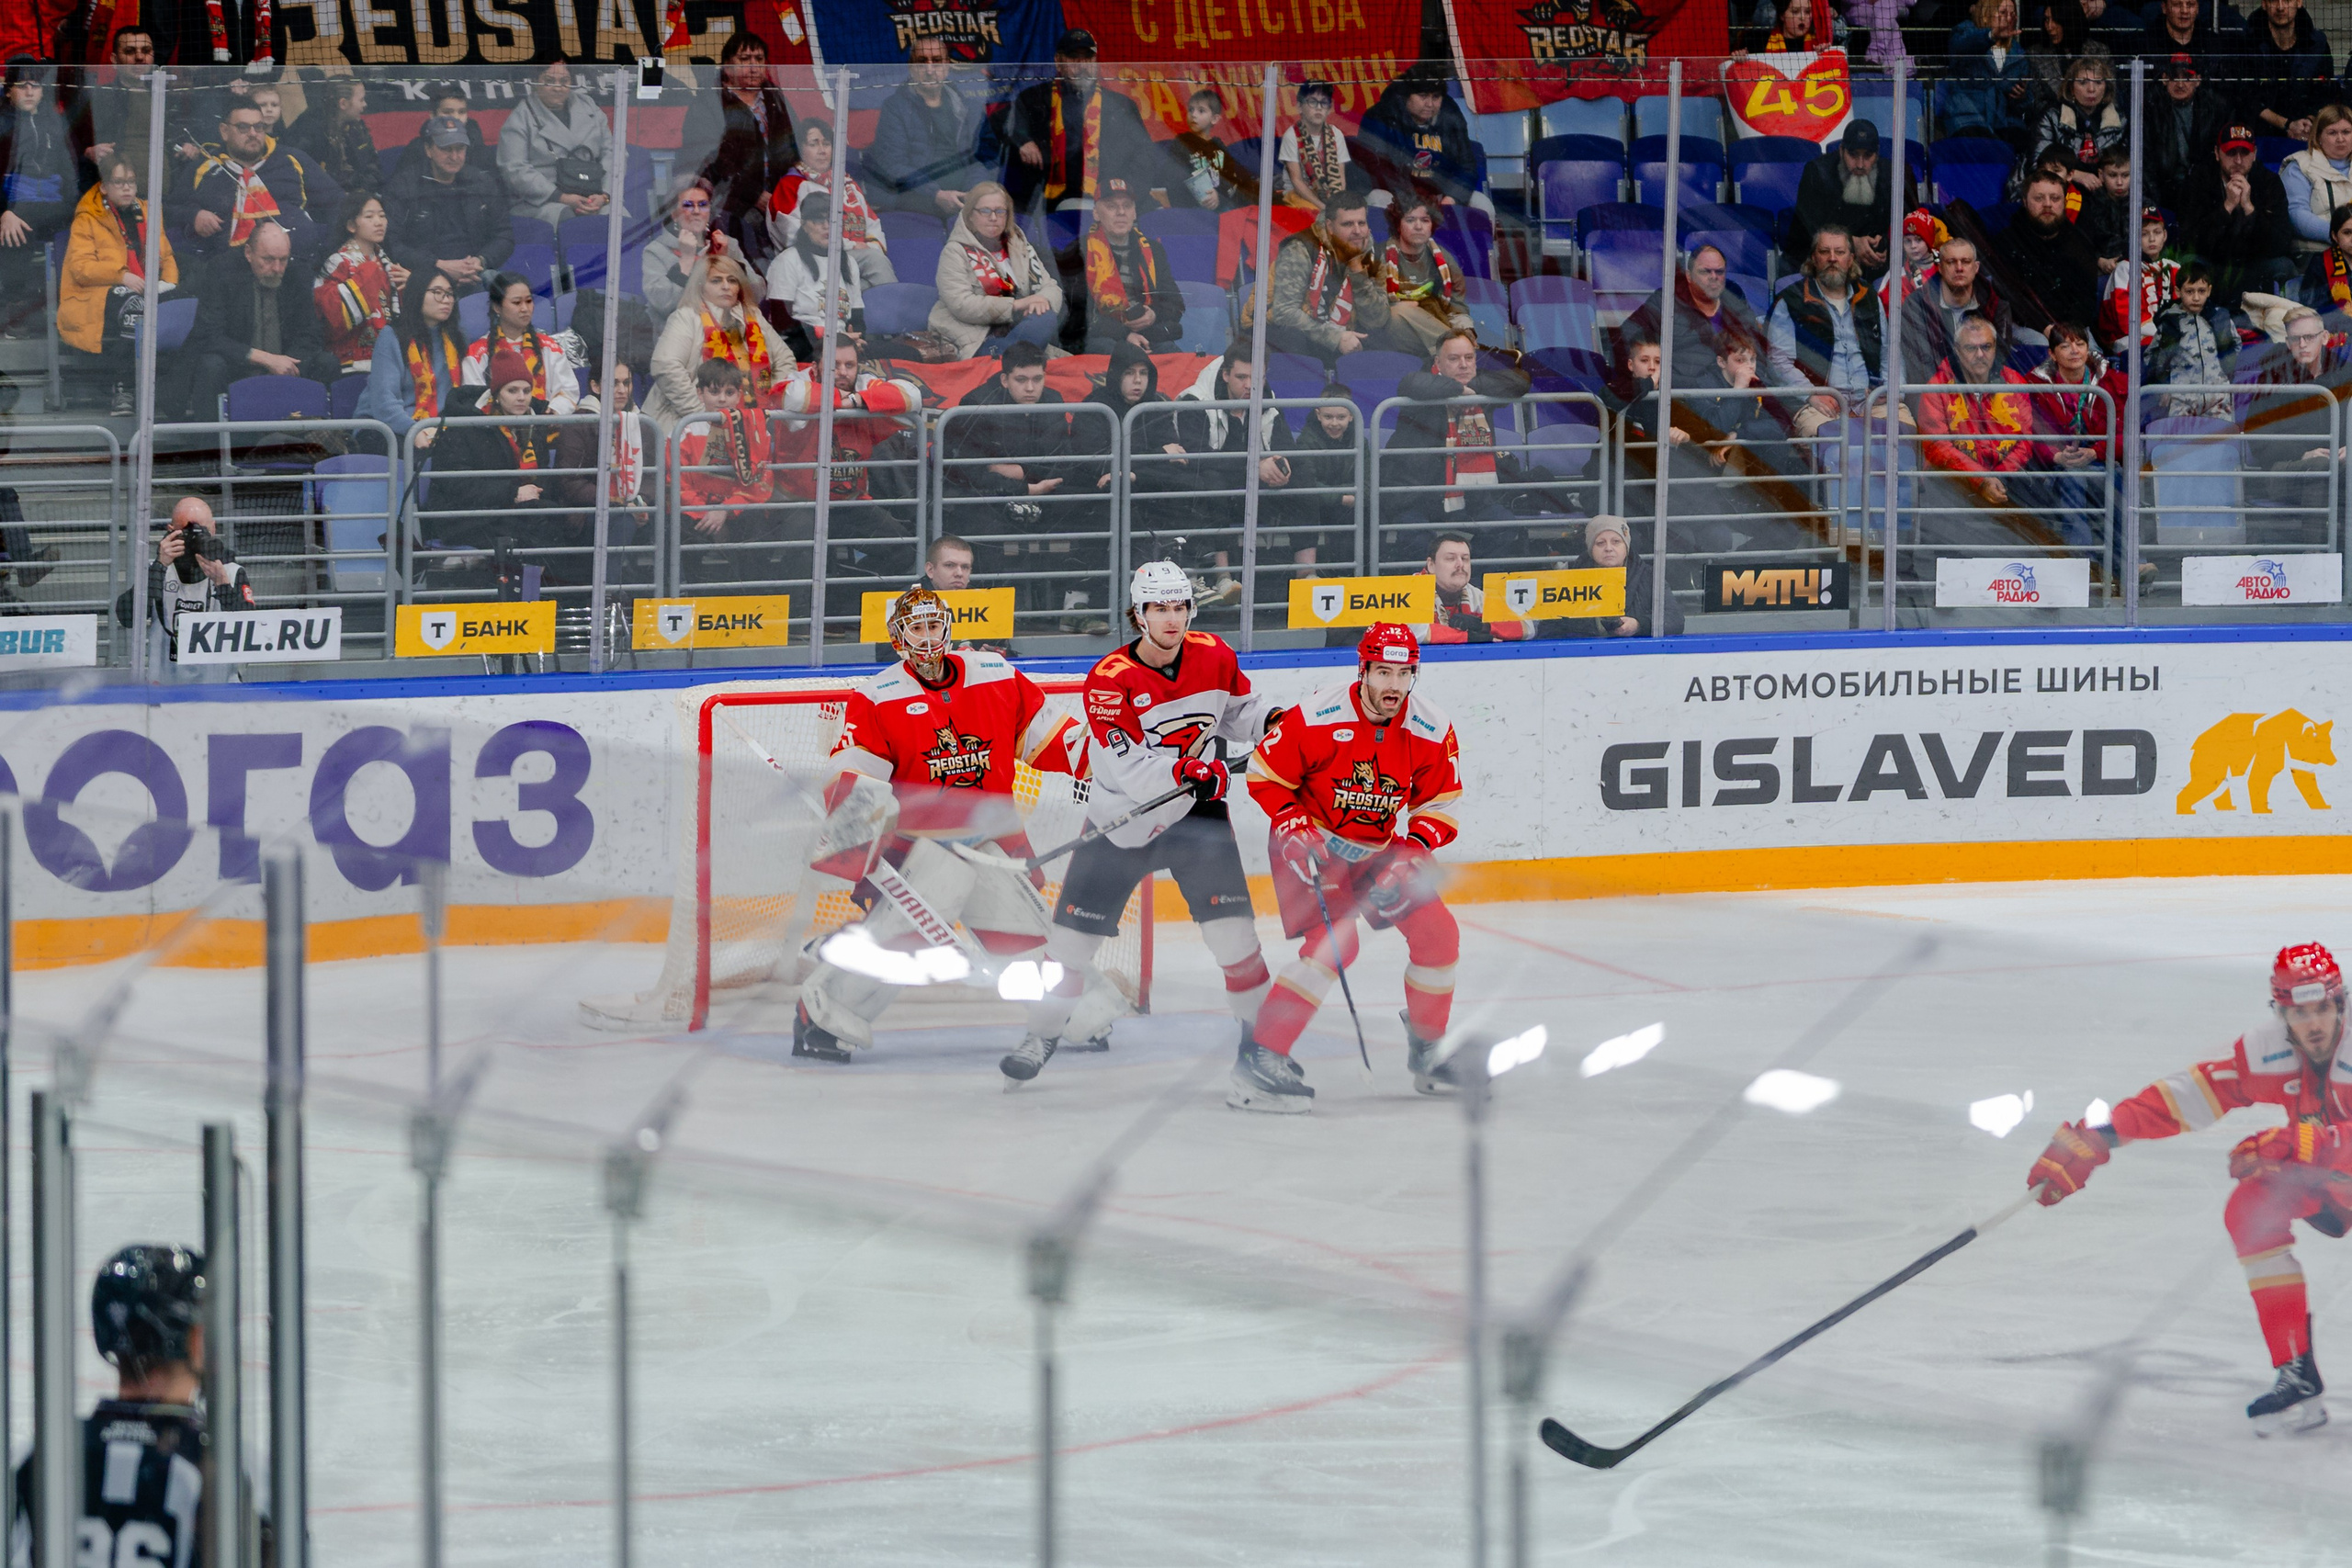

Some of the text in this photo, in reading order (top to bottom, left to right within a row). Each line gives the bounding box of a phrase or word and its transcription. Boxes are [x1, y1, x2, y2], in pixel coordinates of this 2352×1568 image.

[889, 10, 1002, 50] REDSTAR
[1746, 68, 1845, 118] 45
[1161, 567, 1170, 575] 9
[1721, 568, 1832, 606] МАТЧ!
[1986, 579, 2022, 592] АВТО
[2234, 575, 2272, 590] АВТО
[1350, 592, 1411, 610] БАНК
[1542, 585, 1603, 604] БАНК
[1996, 589, 2041, 604] РАДИО
[2245, 586, 2291, 601] РАДИО
[697, 613, 763, 631] БАНК
[946, 606, 989, 624] АНК
[188, 618, 331, 654] KHL.RU
[462, 619, 529, 637] БАНК
[1388, 626, 1402, 636] 12
[1683, 665, 2161, 703] АВТОМОБИЛЬНЫЕ ШИНЫ
[1316, 705, 1341, 717] SIBUR
[1411, 715, 1436, 733] SIBUR
[1105, 728, 1131, 759] 9
[926, 748, 993, 782] REDSTAR
[1600, 728, 2157, 811] GISLAVED
[0, 720, 594, 892] огаз
[1333, 787, 1404, 815] REDSTAR
[880, 875, 965, 953] WARRI
